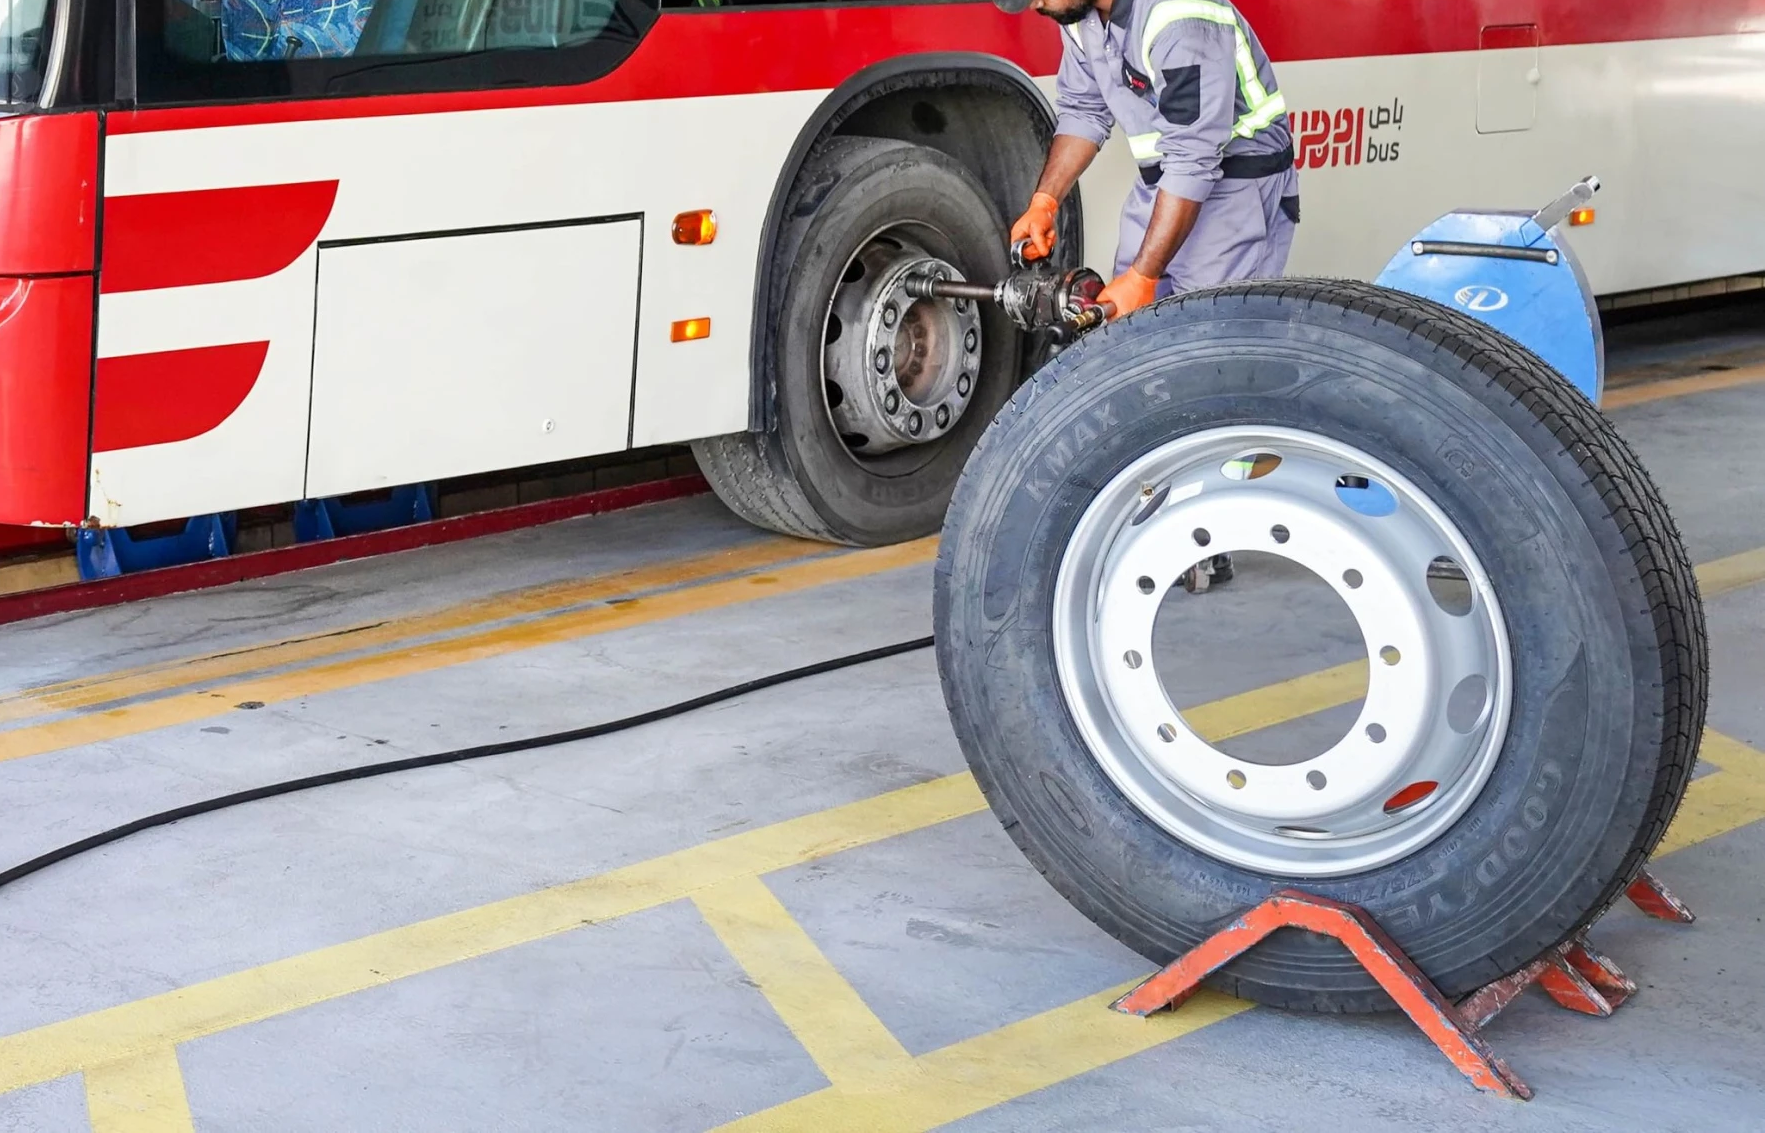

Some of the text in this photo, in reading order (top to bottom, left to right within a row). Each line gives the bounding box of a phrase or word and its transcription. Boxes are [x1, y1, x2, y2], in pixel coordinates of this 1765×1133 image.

[1288, 106, 1365, 170] UBAI
[1368, 96, 1404, 131] باص
[1366, 136, 1400, 164] bus
[1024, 378, 1172, 502] KMAX S
[1384, 758, 1564, 931] GOODYE
